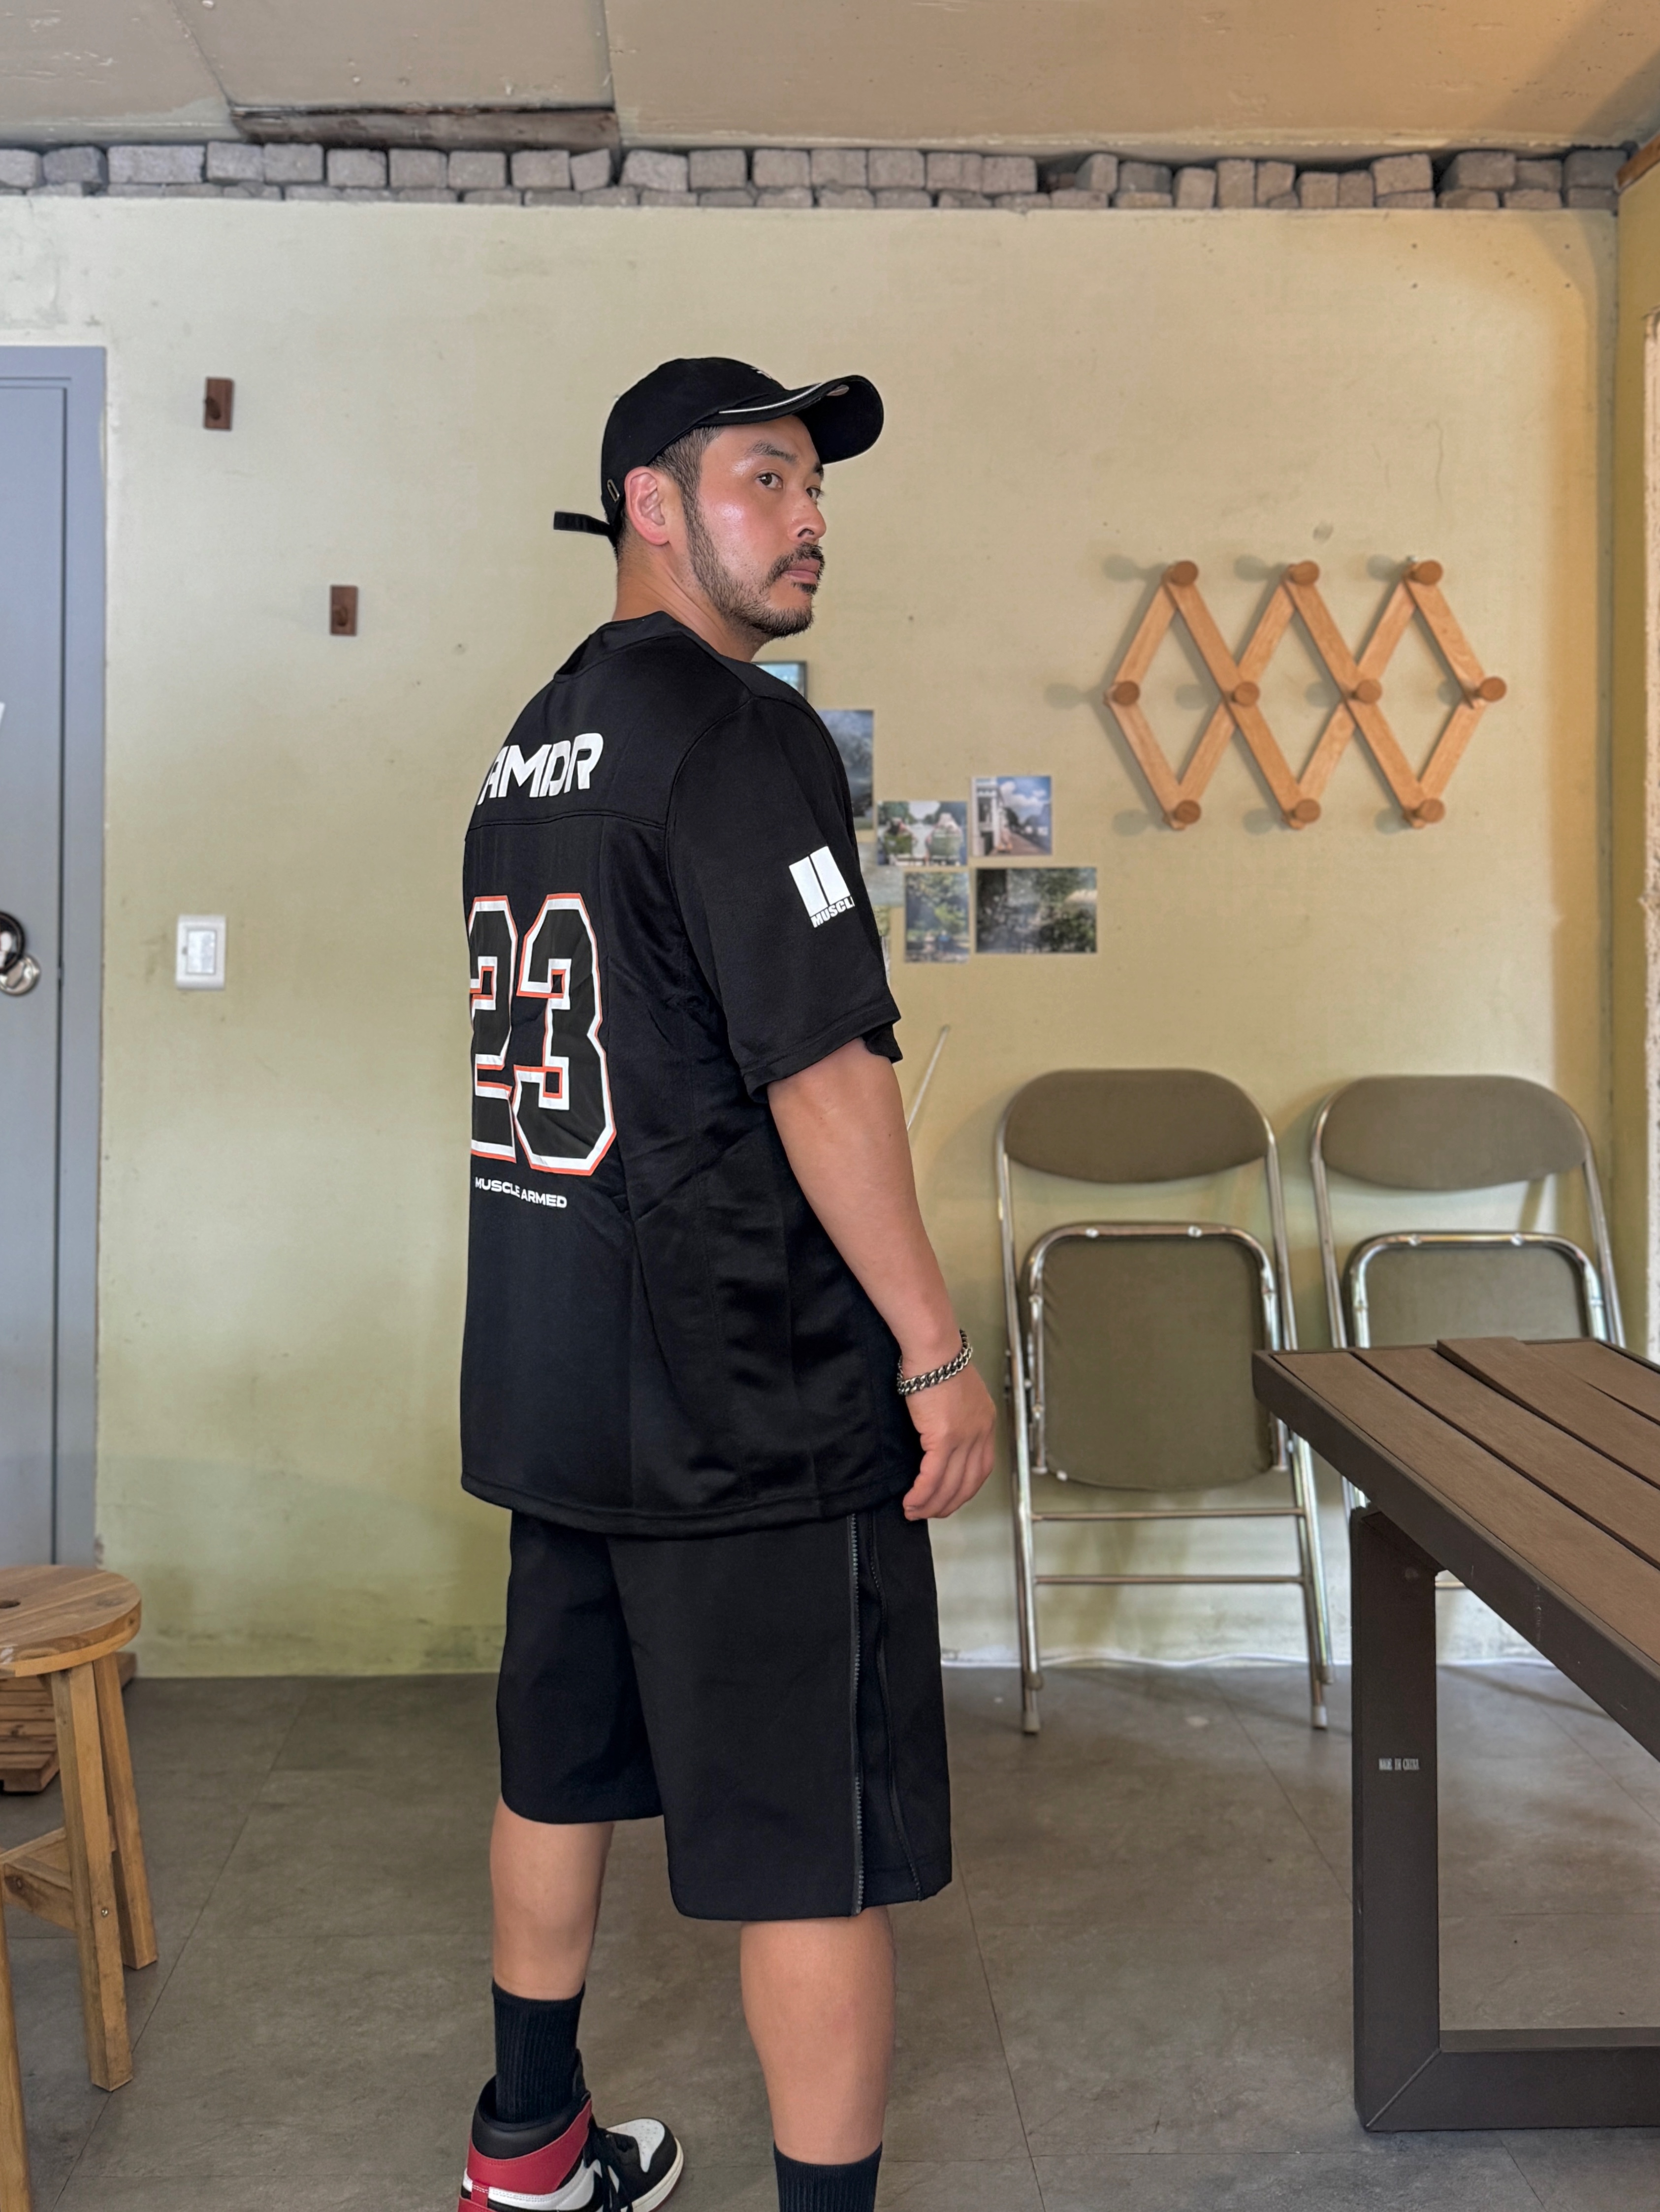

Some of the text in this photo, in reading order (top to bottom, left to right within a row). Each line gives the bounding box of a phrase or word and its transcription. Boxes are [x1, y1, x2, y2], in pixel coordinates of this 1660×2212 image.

[810, 896, 856, 928] MUSCL
[468, 892, 617, 1176] 23
[475, 1176, 567, 1208] MUSCLE ARMED
